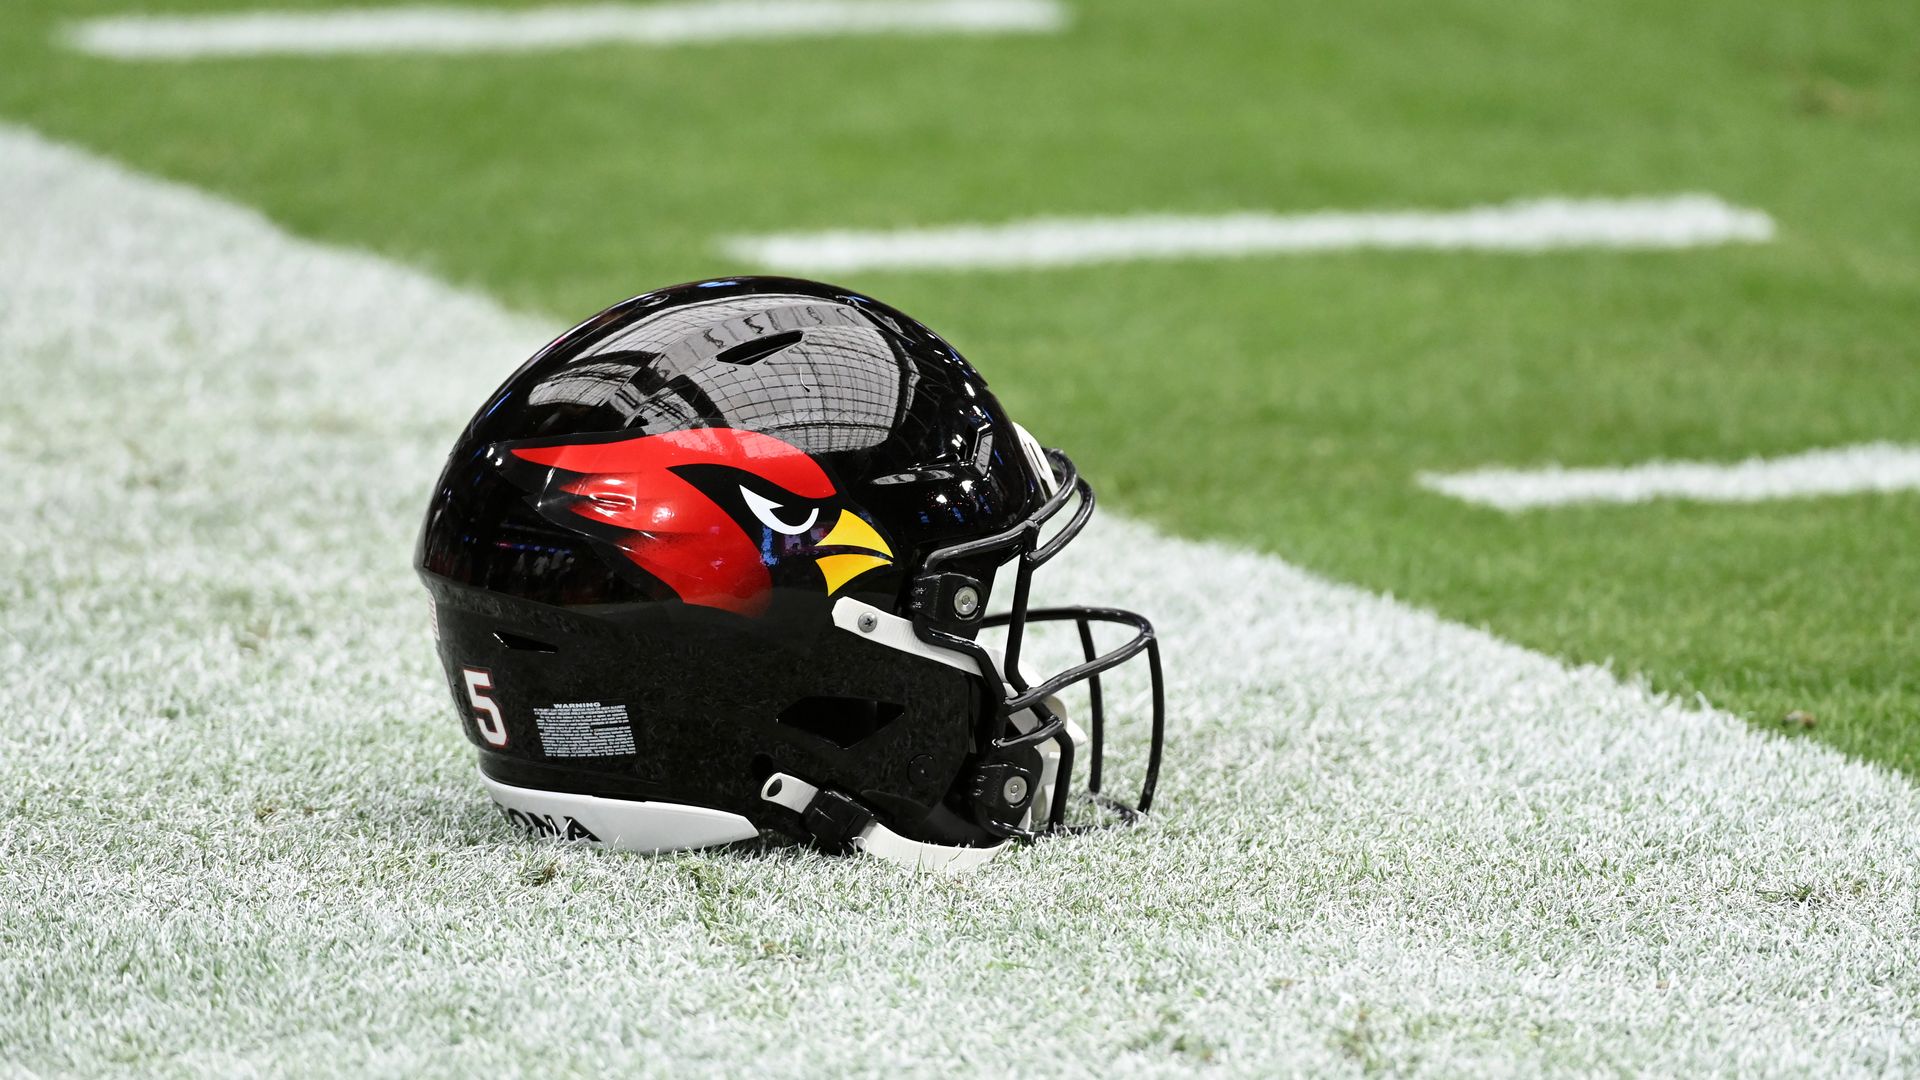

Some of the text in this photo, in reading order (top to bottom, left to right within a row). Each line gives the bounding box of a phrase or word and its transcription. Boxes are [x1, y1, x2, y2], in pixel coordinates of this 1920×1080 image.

[463, 668, 507, 747] 5
[553, 702, 601, 710] WARNING
[496, 801, 602, 842] ONA
